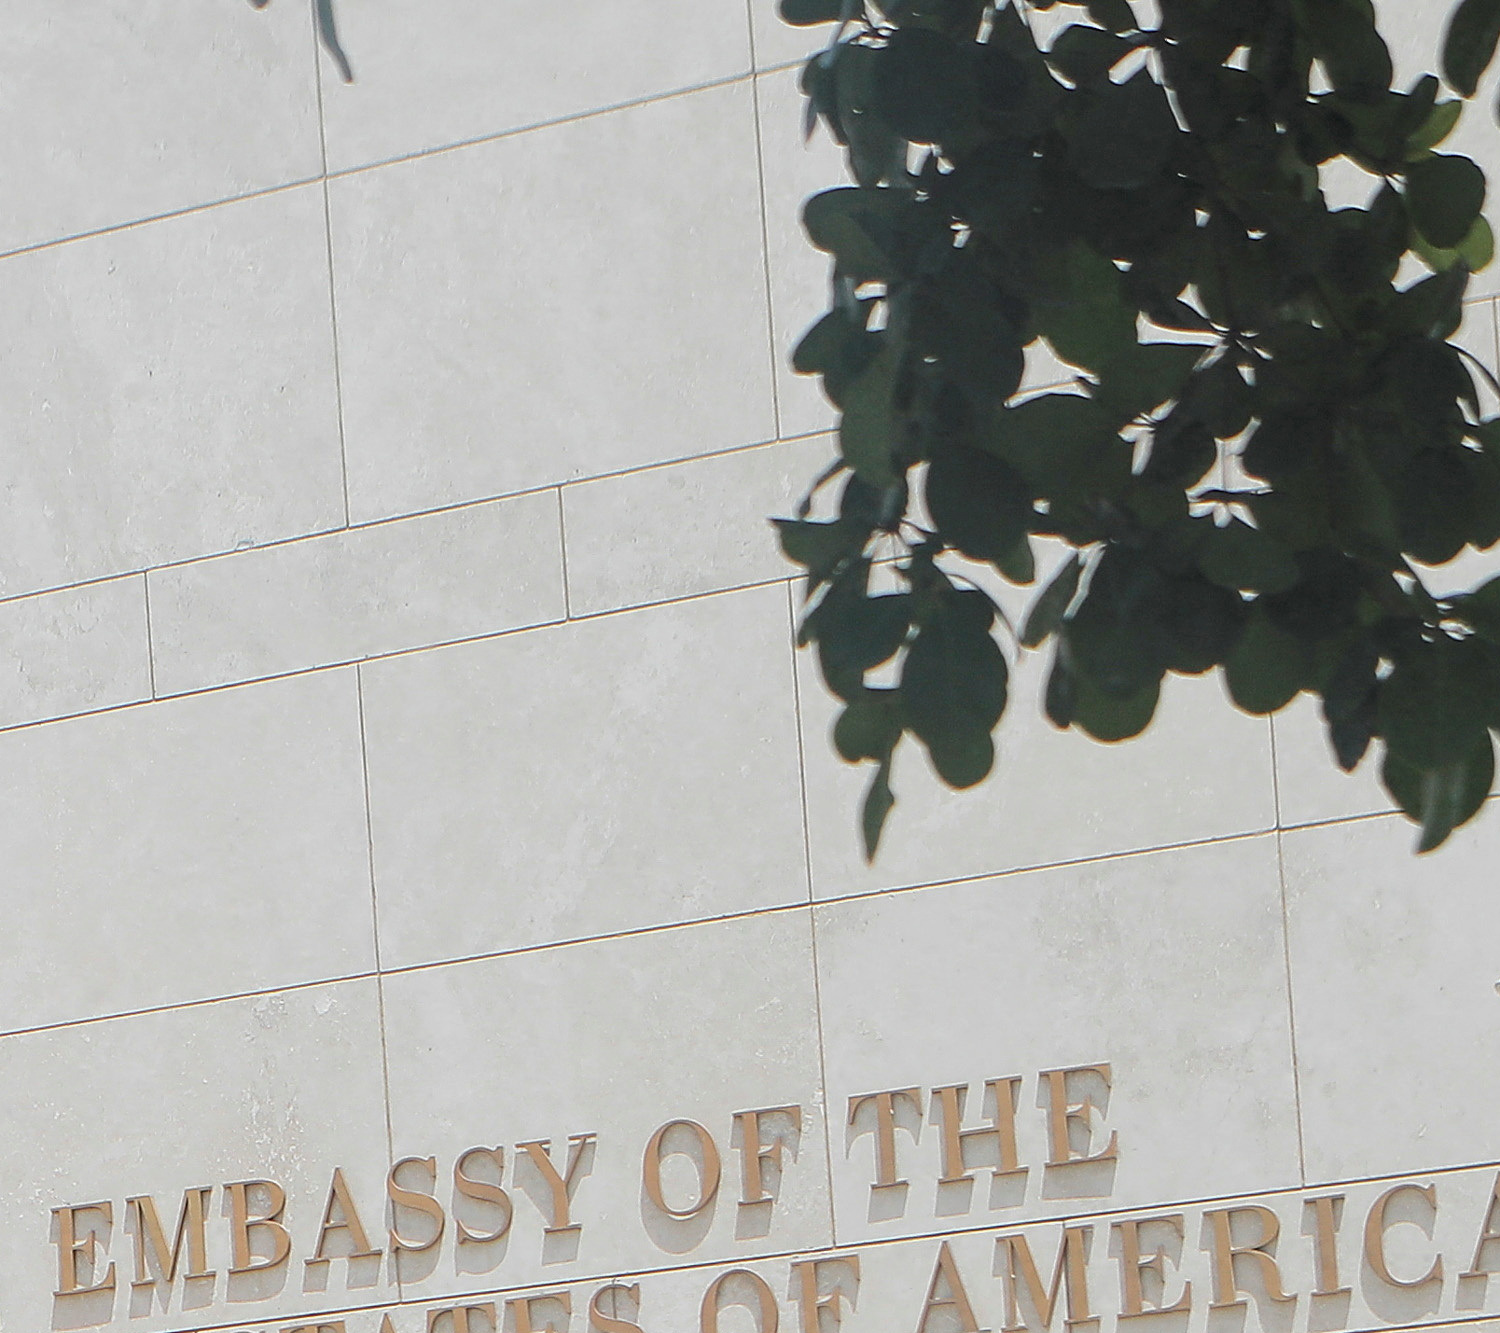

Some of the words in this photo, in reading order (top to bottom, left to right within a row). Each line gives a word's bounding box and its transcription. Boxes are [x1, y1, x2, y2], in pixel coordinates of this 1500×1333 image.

[50, 1132, 597, 1295] EMBASSY
[642, 1104, 800, 1216] OF
[848, 1062, 1118, 1188] THE
